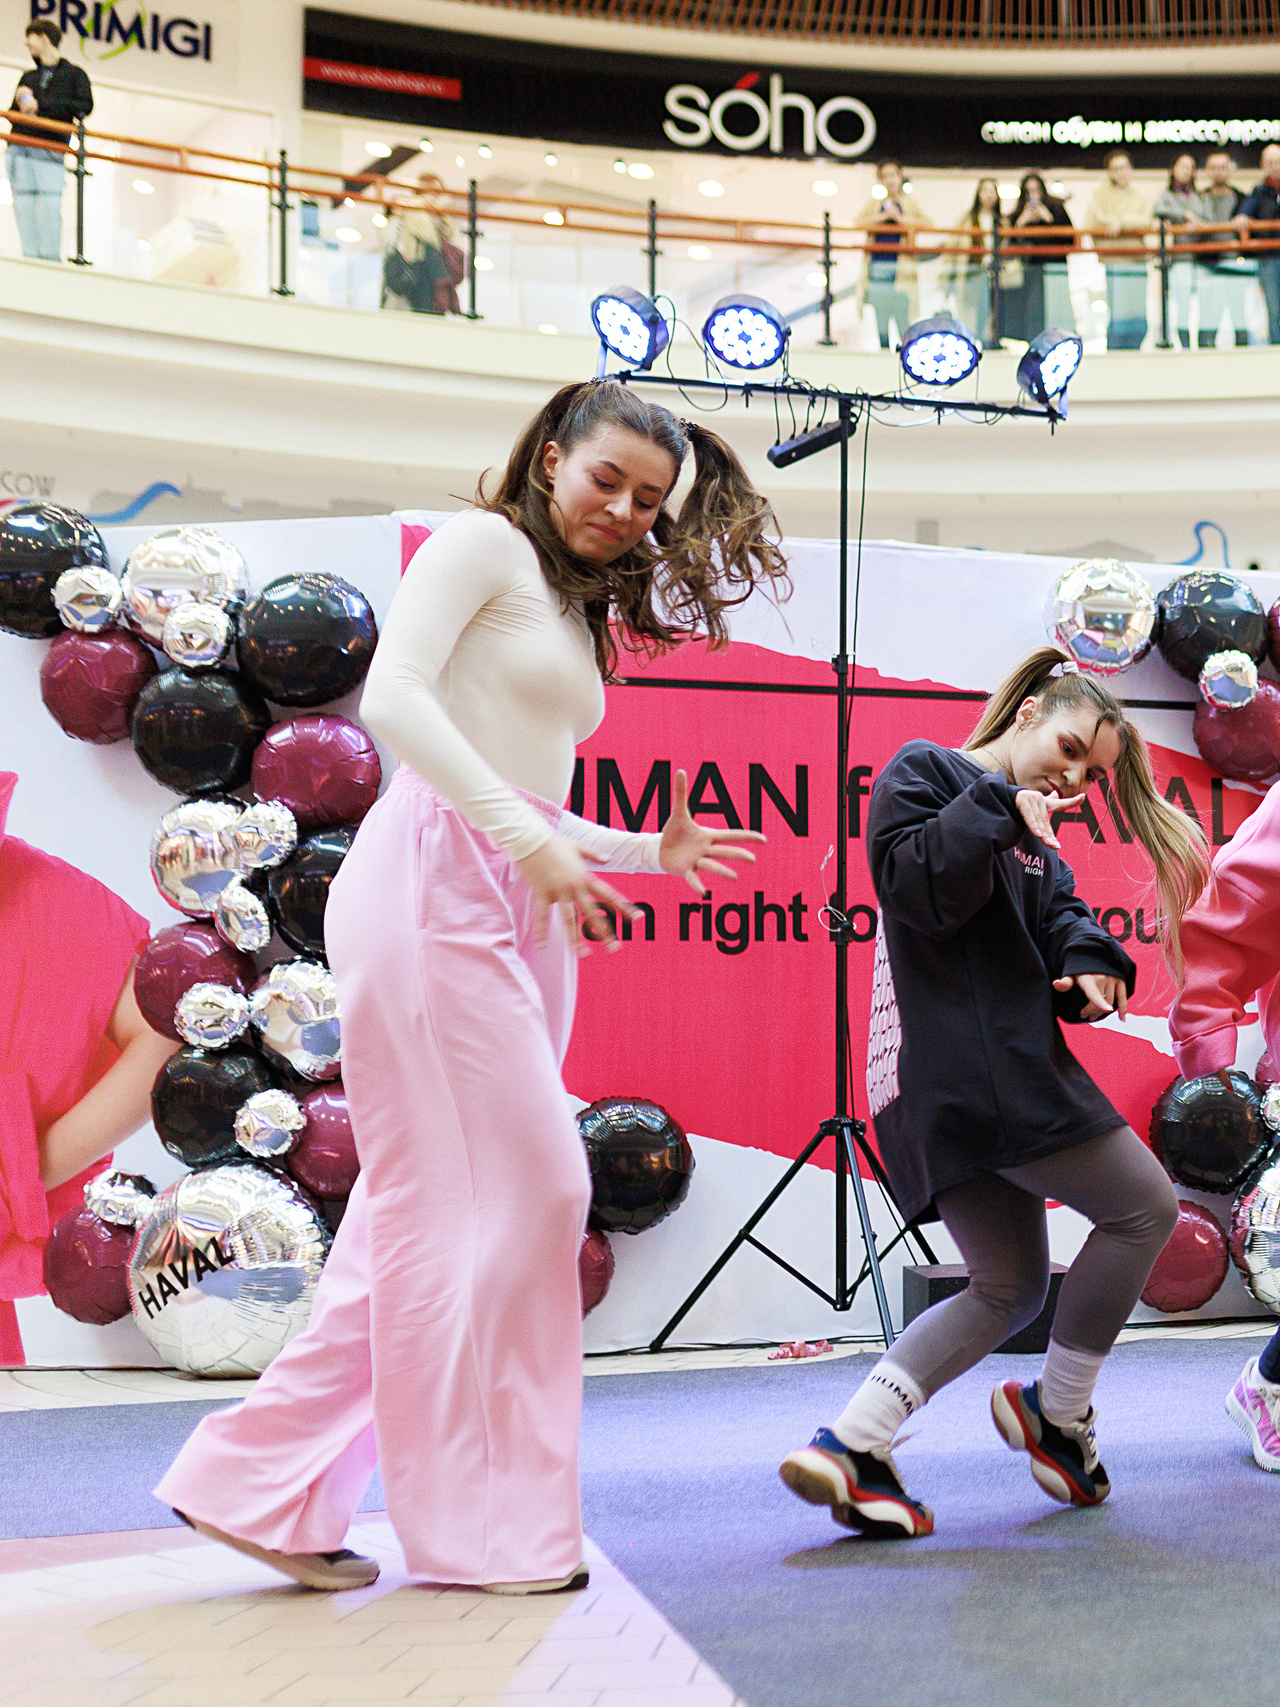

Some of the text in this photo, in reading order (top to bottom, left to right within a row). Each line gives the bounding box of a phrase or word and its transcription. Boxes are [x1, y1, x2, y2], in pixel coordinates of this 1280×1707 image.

[30, 0, 212, 61] PRIMIGI
[0, 471, 56, 497] COW
[568, 757, 808, 838] MAN
[1024, 866, 1044, 877] RIGH
[679, 891, 808, 955] right
[138, 1236, 235, 1319] HAVAL
